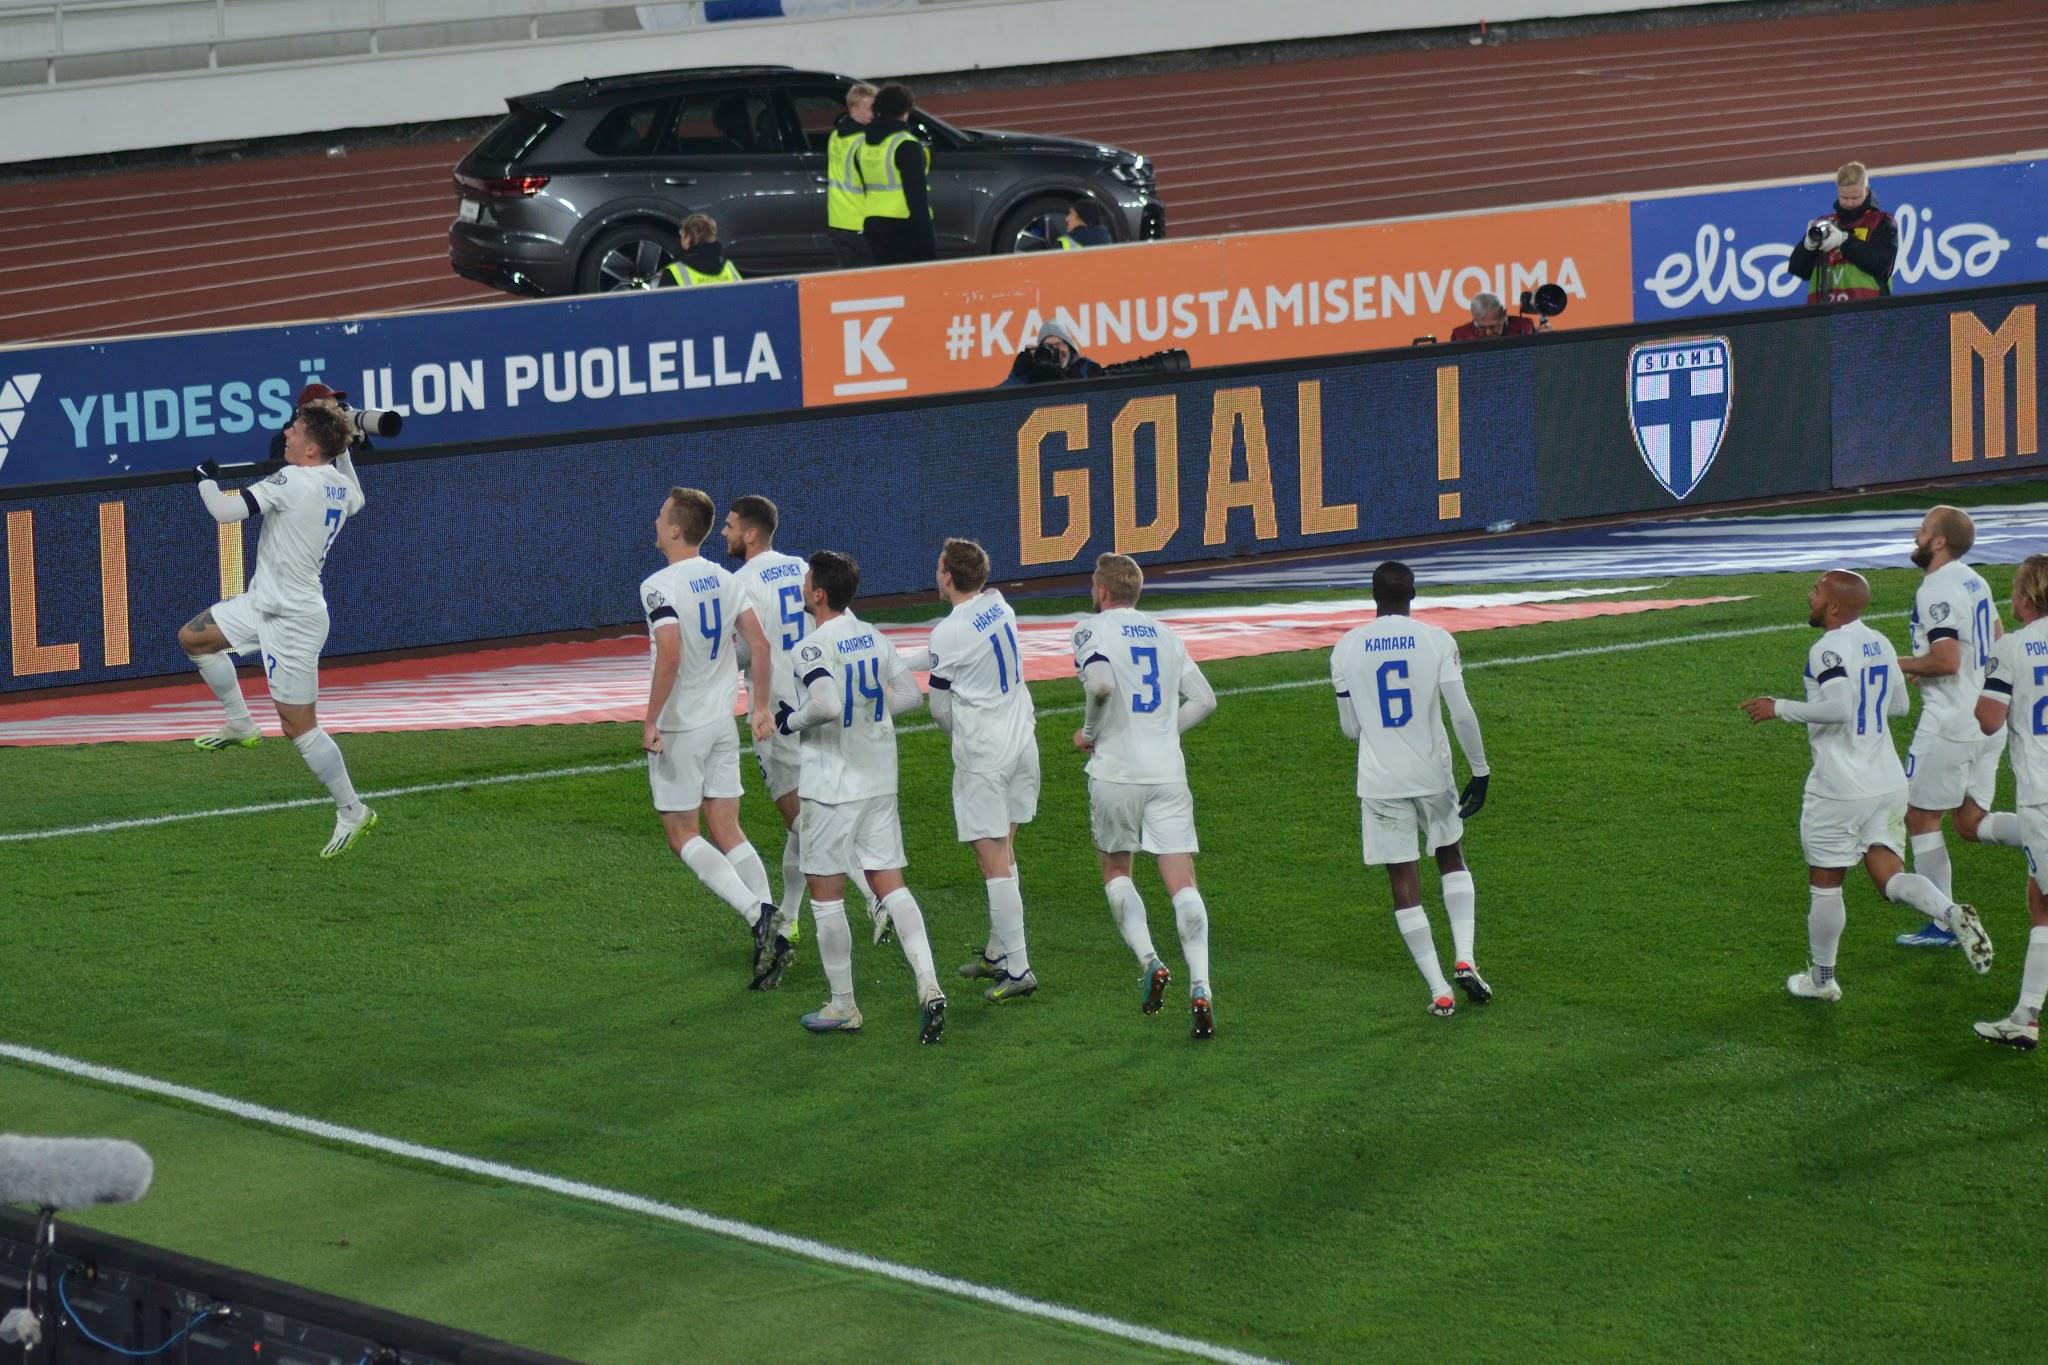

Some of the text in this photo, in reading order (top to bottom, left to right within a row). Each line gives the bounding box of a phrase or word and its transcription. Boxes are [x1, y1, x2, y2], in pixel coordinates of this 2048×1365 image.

[1644, 224, 1803, 309] elisa
[1893, 203, 2011, 284] lisa
[363, 359, 485, 417] ILON
[505, 332, 782, 407] PUOLELLA
[843, 315, 894, 376] K
[1645, 349, 1715, 370] SUOMI
[1018, 379, 1359, 565] GOAL
[323, 509, 343, 562] 7
[689, 576, 721, 593] IVANOV
[778, 585, 805, 650] 5
[699, 598, 721, 660] 4
[989, 622, 1020, 694] 11
[1121, 625, 1157, 638] JENSEN
[1365, 636, 1416, 652] KAMARA
[843, 657, 884, 728] 14
[1130, 646, 1161, 713] 3
[1376, 660, 1413, 728] 6
[1857, 665, 1888, 735] 17
